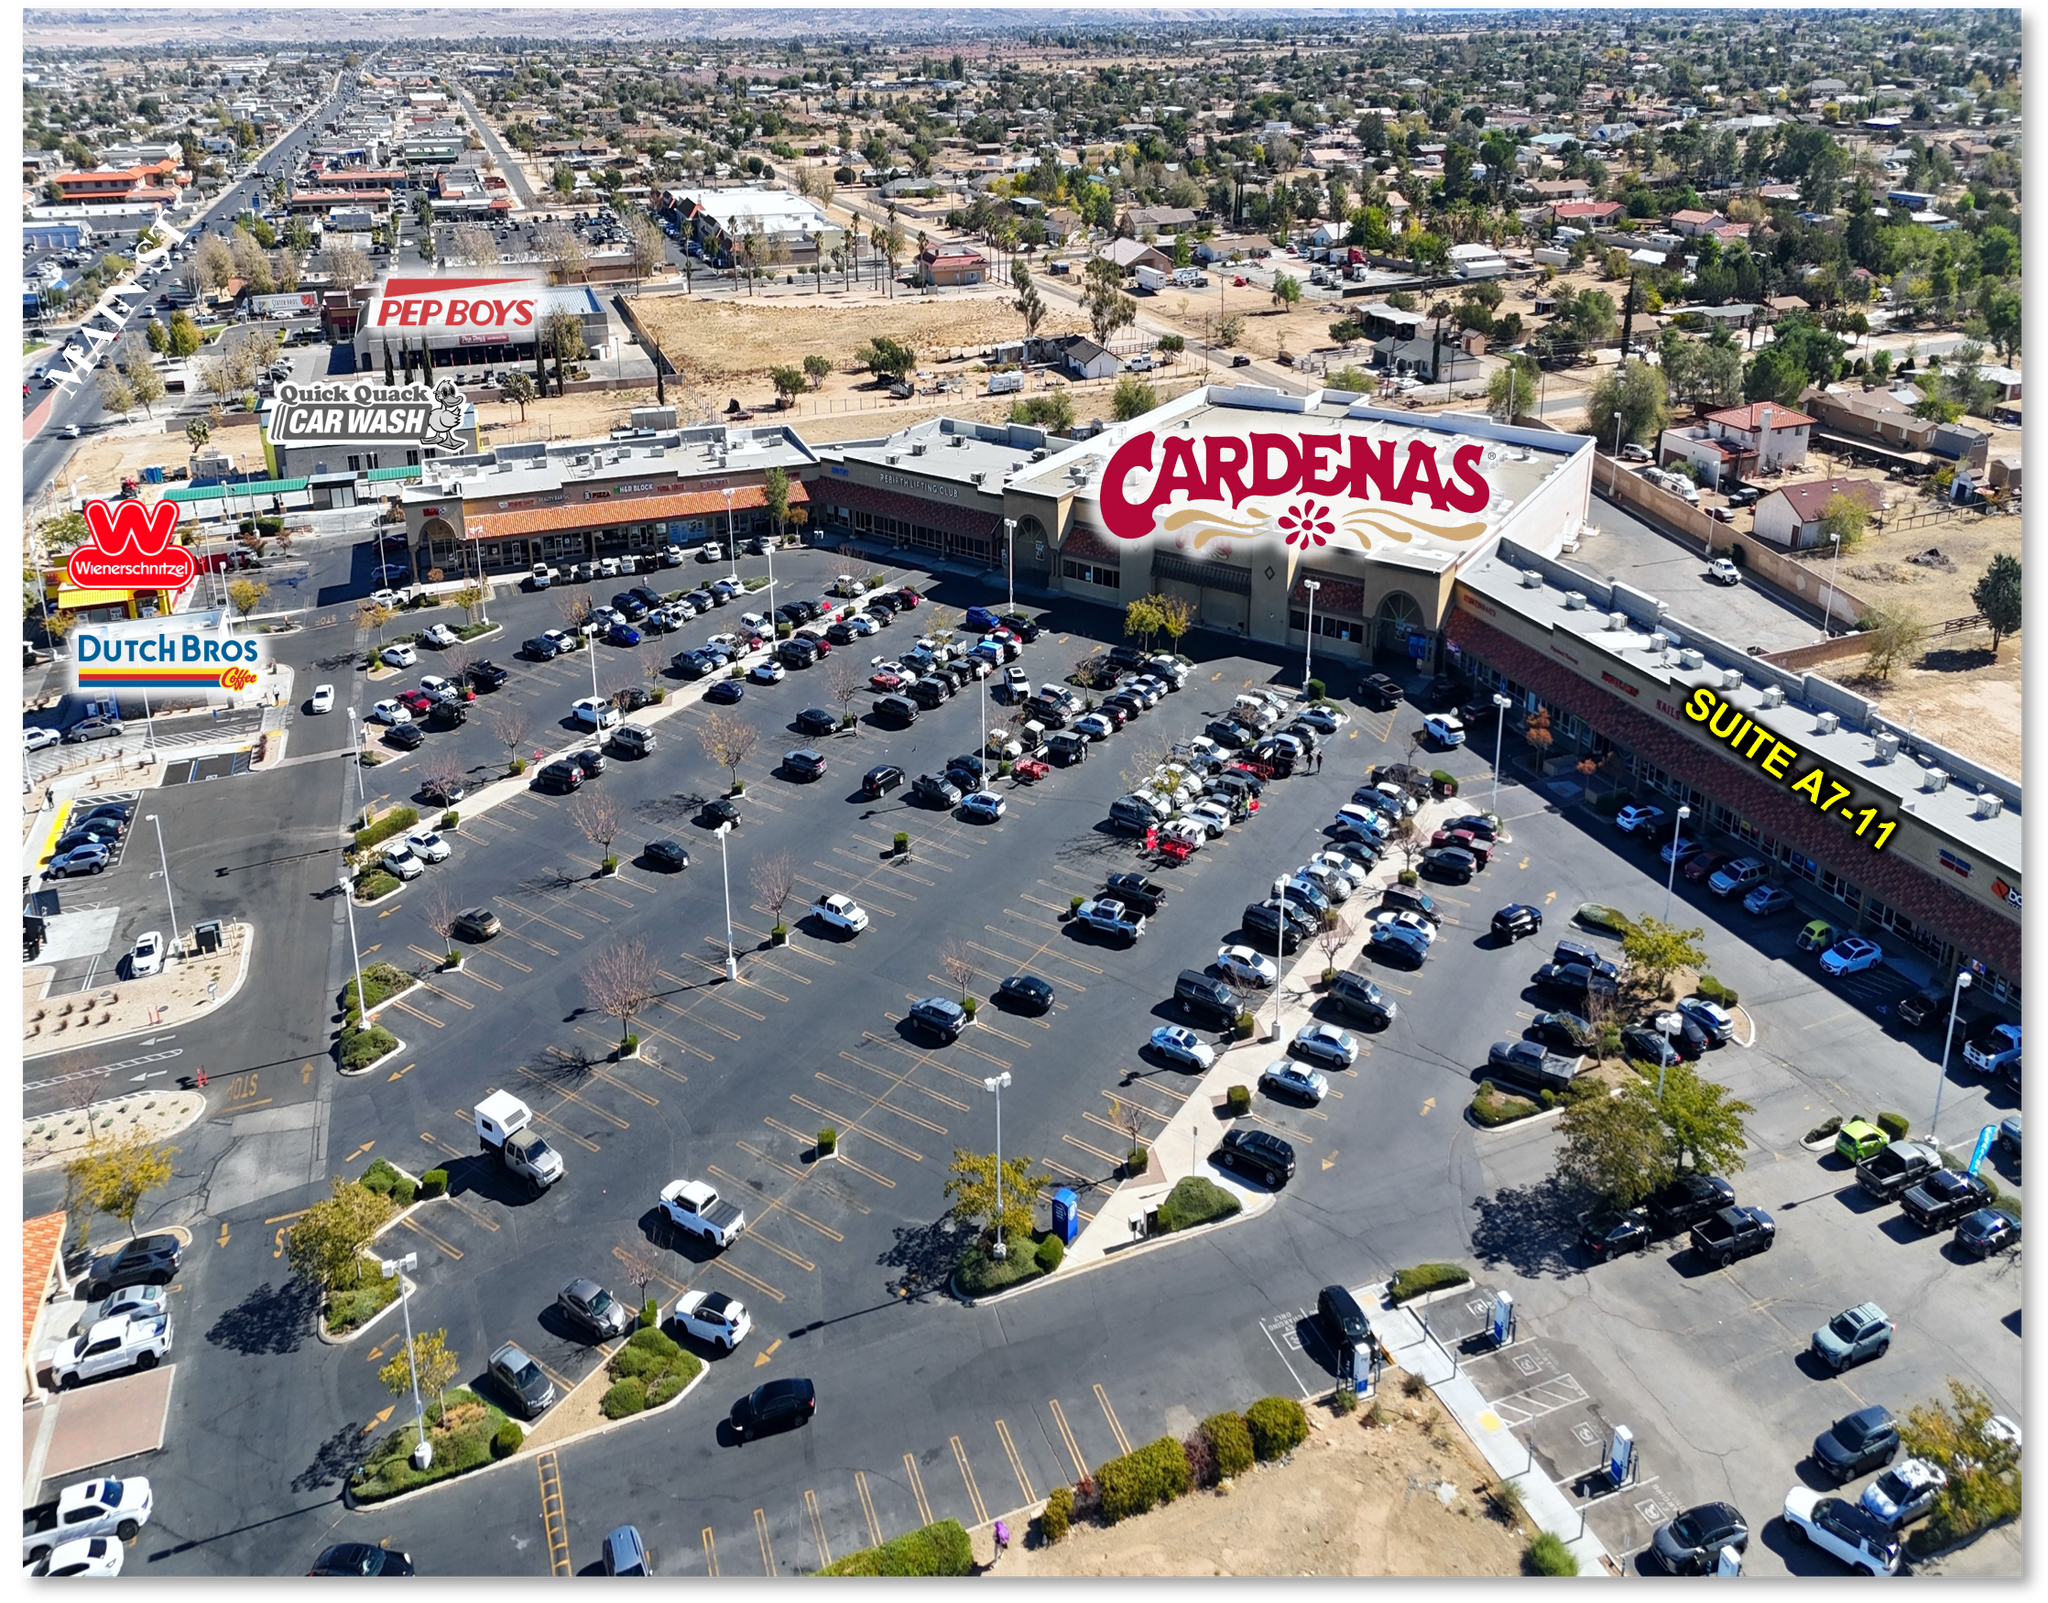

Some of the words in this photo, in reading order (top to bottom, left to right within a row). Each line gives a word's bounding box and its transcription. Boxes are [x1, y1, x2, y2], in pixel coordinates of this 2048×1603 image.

[633, 482, 653, 493] BLOCK
[939, 486, 959, 498] CLUB
[591, 489, 612, 500] PIZZA
[1656, 699, 1681, 721] NAILS
[225, 1072, 259, 1101] STOP
